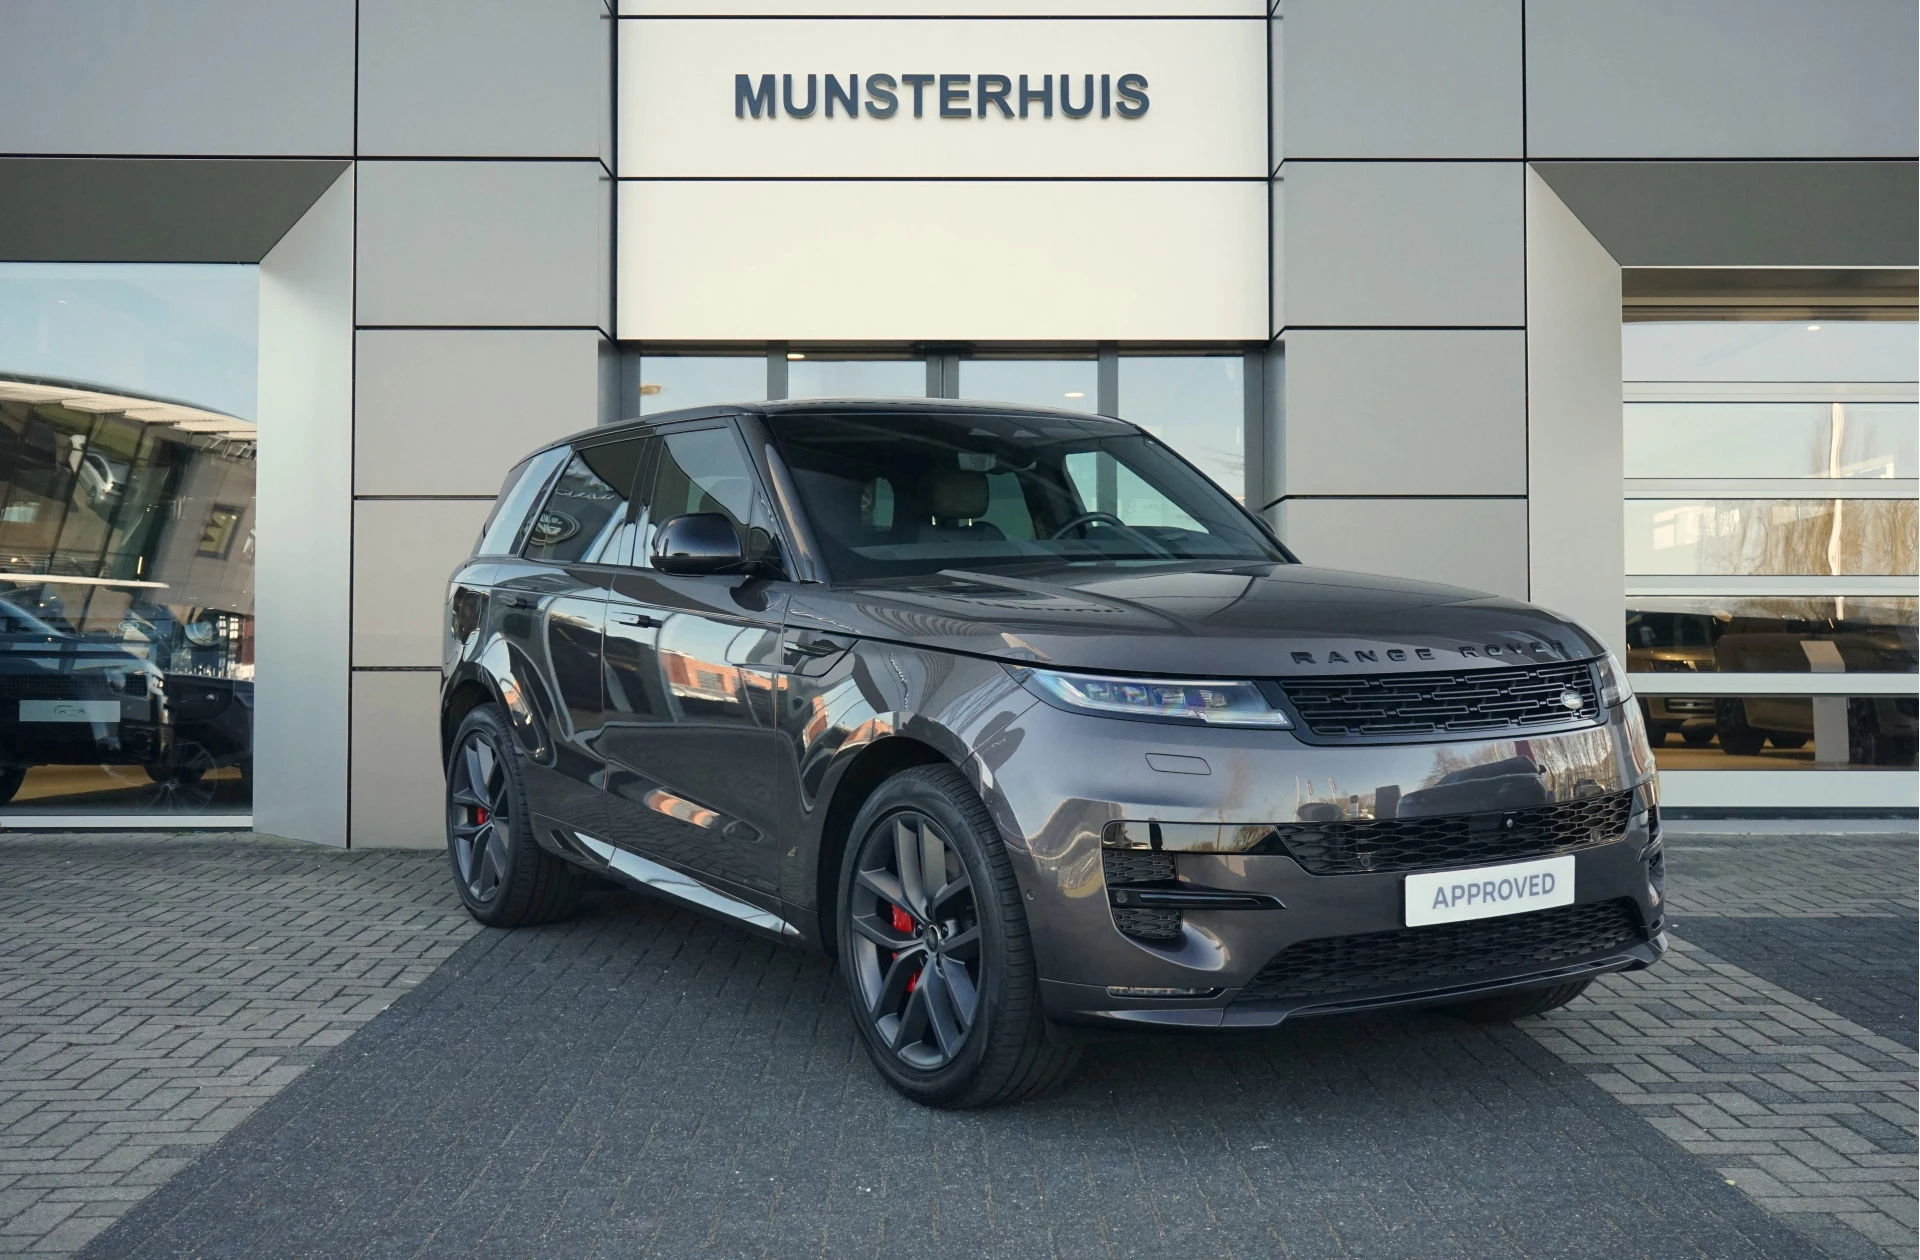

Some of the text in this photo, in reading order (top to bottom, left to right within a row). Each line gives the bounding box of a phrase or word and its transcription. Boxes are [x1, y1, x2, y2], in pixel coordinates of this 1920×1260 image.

[734, 73, 1151, 119] MUNSTERHUIS
[1290, 648, 1436, 665] RANGE
[1431, 872, 1556, 910] APPROVED
